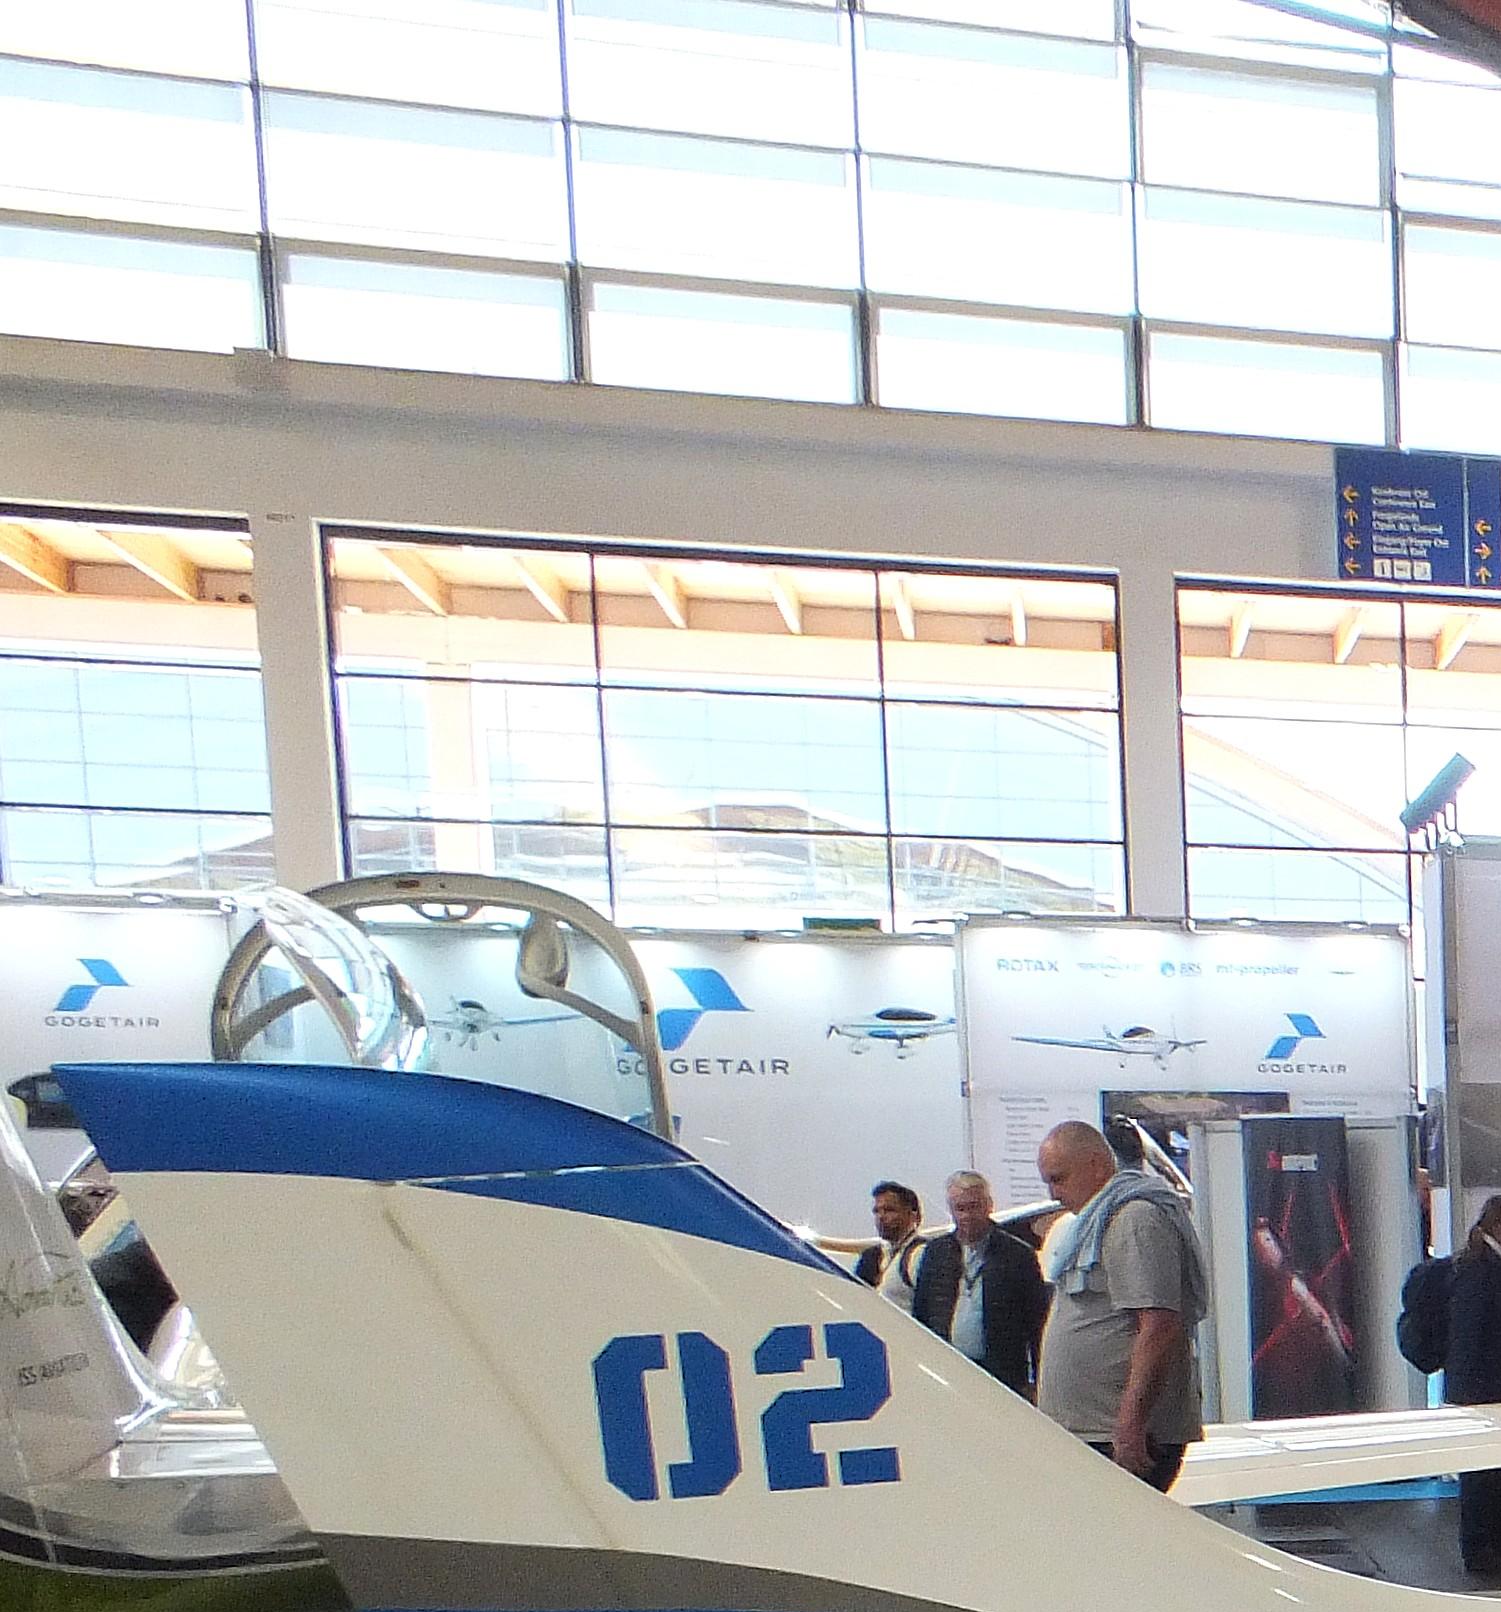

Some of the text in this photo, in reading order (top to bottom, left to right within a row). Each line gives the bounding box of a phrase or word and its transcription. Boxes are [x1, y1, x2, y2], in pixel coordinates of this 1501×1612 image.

[997, 958, 1059, 973] ROTAX
[44, 1015, 160, 1029] GOGETAIR
[1257, 1063, 1347, 1074] GOGETAIR
[592, 1321, 901, 1501] 02
